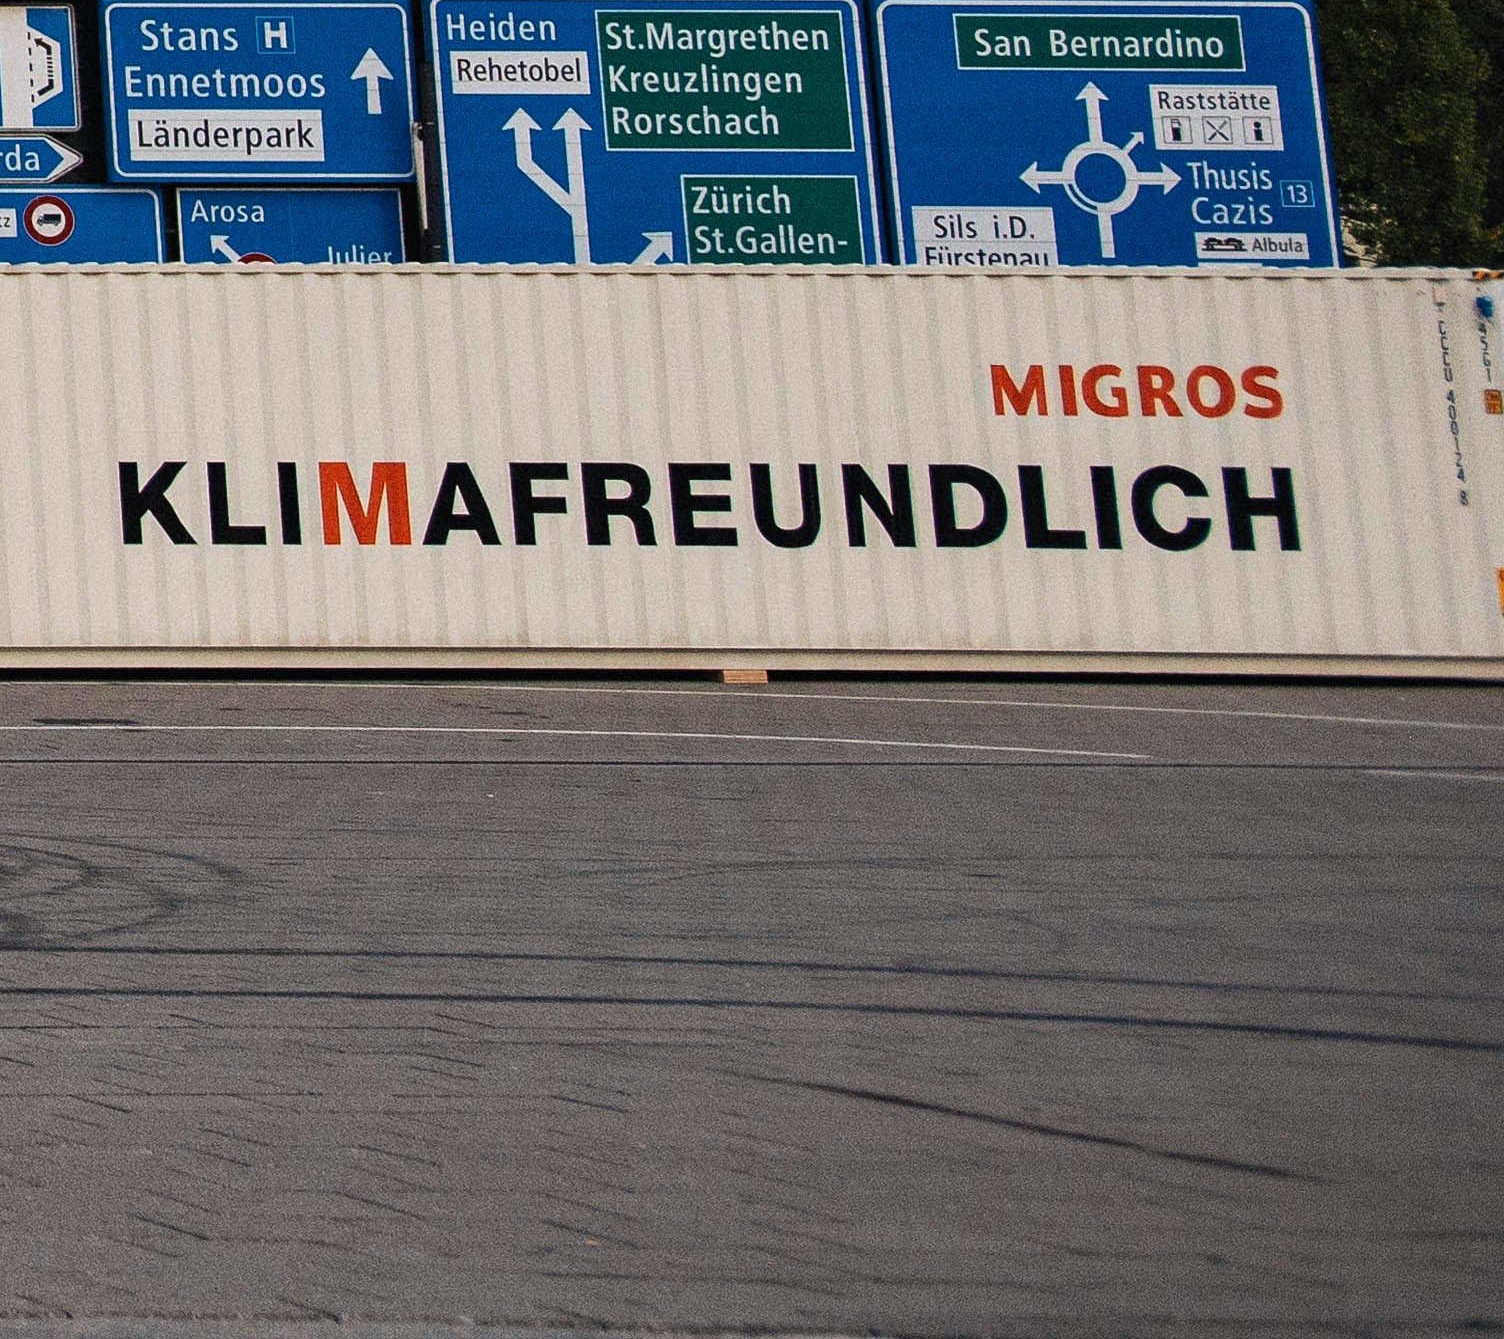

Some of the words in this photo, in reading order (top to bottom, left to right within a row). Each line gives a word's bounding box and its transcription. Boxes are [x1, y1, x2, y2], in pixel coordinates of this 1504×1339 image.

[446, 11, 556, 41] Heiden
[605, 20, 829, 58] St.Margrethen
[974, 28, 1031, 57] San
[1049, 28, 1224, 58] Bernardino
[124, 65, 326, 98] Ennetmoos
[691, 184, 791, 214] Zürich
[1287, 184, 1308, 204] 13
[933, 213, 978, 239] Sils
[992, 214, 1035, 239] i.D.
[990, 364, 1284, 418] MIGROS
[118, 461, 1302, 552] KLIMAFREUNDLICH
